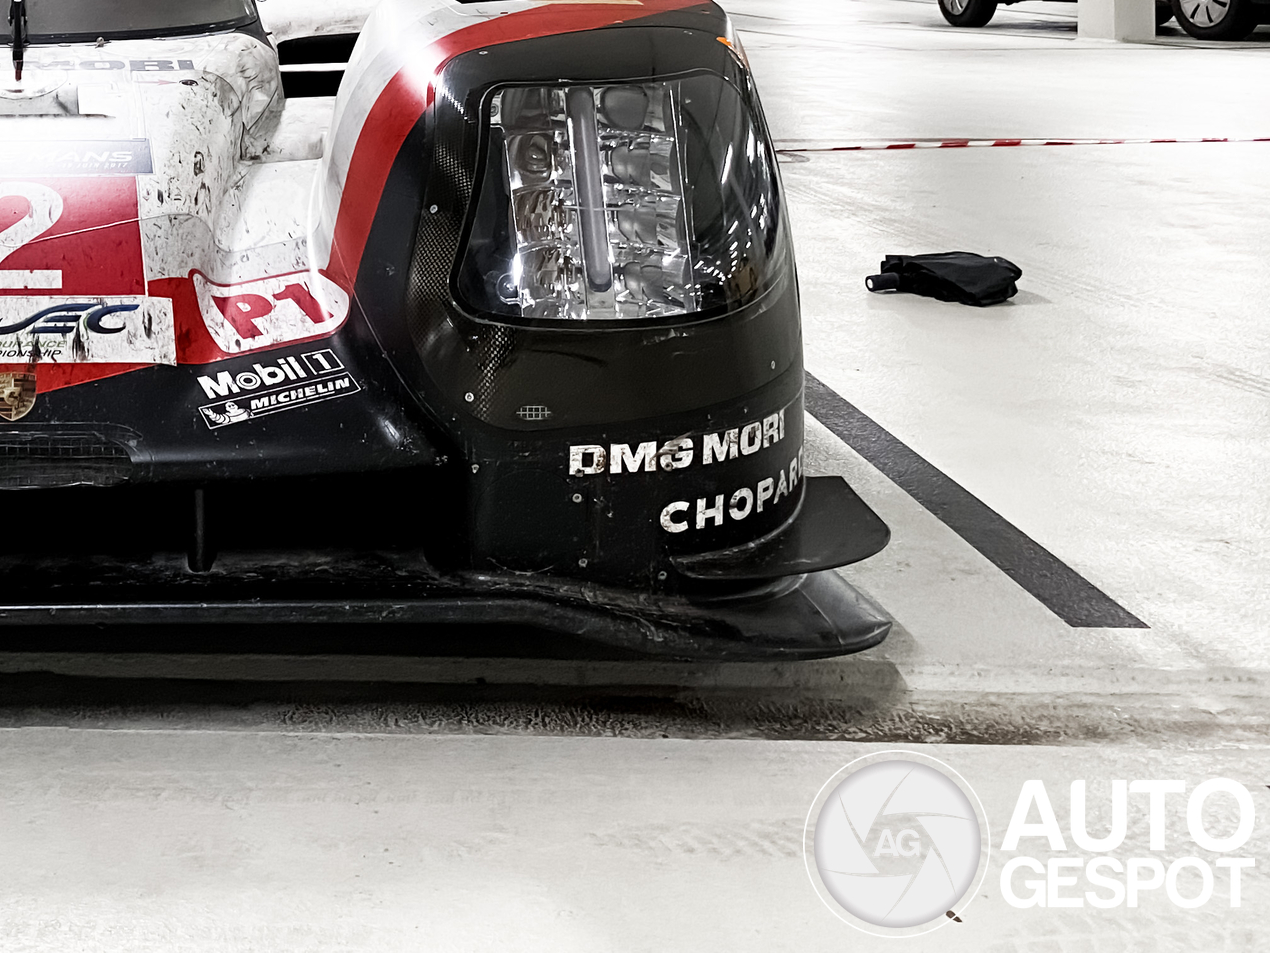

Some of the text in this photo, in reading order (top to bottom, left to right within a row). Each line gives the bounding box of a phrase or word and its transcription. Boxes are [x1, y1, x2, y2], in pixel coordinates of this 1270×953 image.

[20, 59, 197, 72] MORI
[26, 150, 133, 163] MANS
[211, 282, 334, 340] P1
[197, 353, 332, 400] Mobil 1
[250, 377, 351, 411] MICHELIN
[568, 409, 786, 476] DMG MORI
